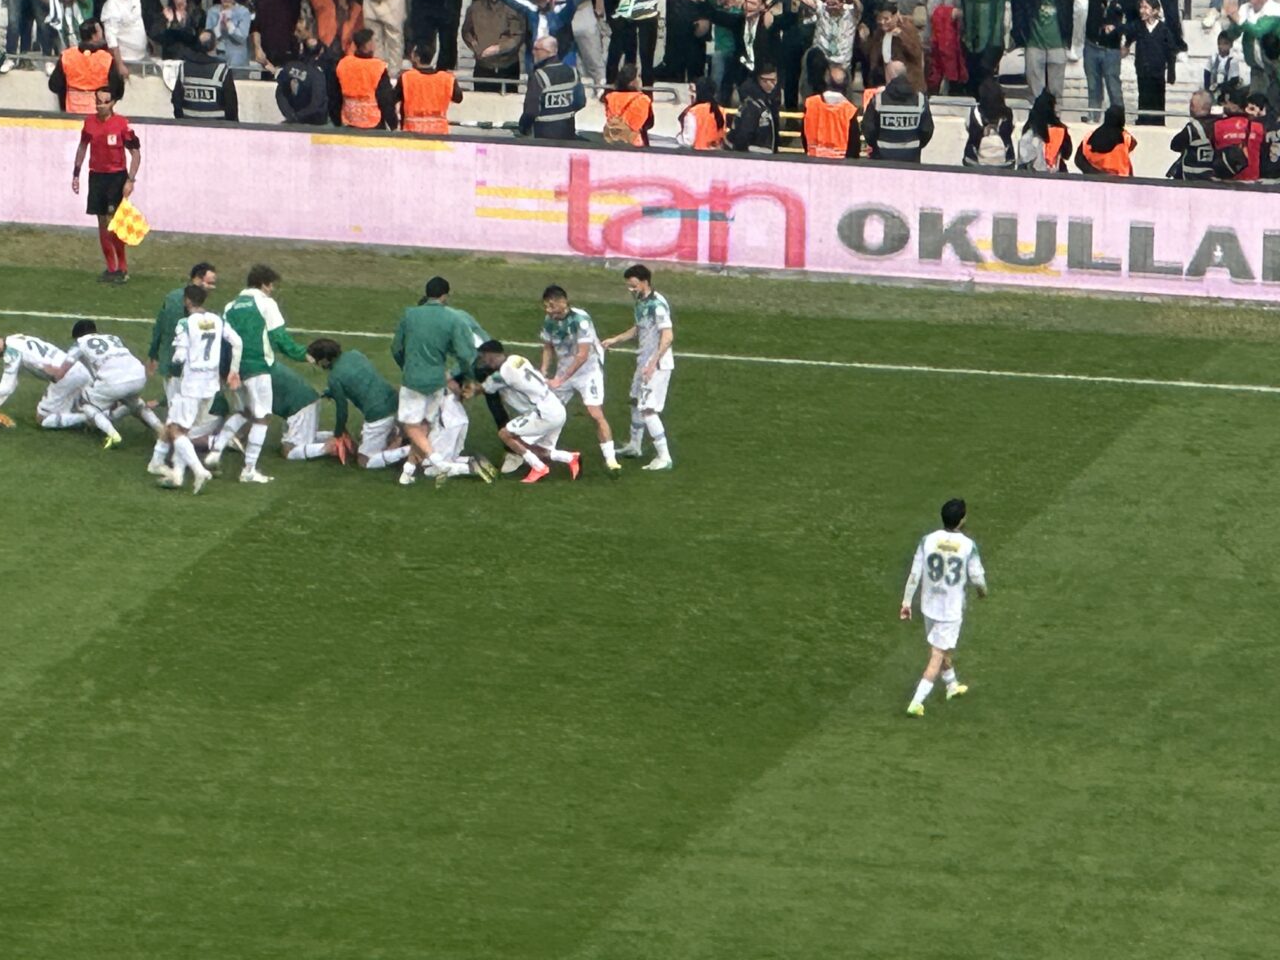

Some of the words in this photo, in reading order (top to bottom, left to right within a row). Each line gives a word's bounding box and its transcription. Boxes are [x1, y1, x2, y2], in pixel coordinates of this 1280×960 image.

[555, 152, 806, 269] tan
[27, 340, 49, 358] 2
[200, 332, 217, 362] 7
[927, 551, 963, 587] 93
